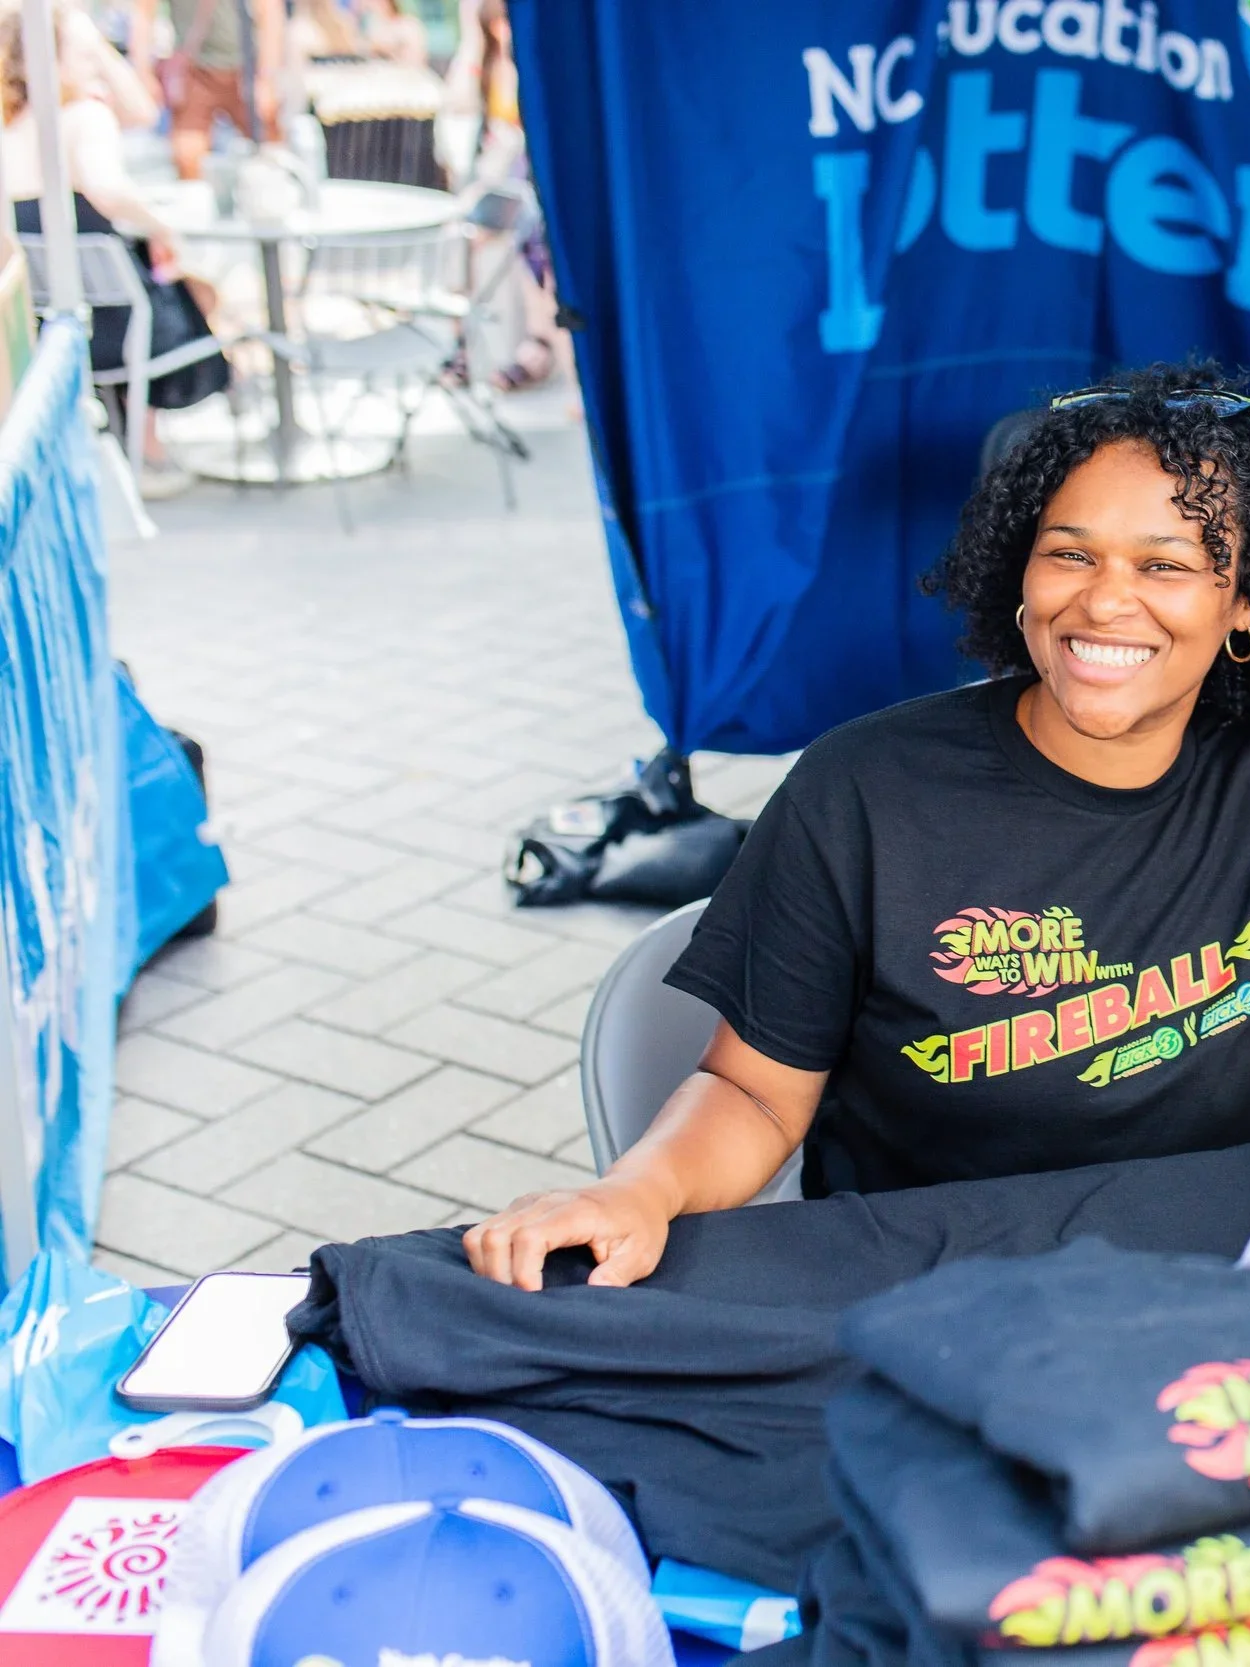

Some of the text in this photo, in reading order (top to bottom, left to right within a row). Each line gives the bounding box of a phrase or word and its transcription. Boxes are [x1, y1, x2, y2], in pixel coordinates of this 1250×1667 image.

[803, 0, 1233, 137] NC ucation
[971, 917, 1085, 956] MORE
[975, 950, 1134, 987] WAYS TO WIN WITH
[950, 941, 1237, 1084] FIREBALL
[1202, 1001, 1239, 1030] PICK
[1116, 1044, 1154, 1071] PICK
